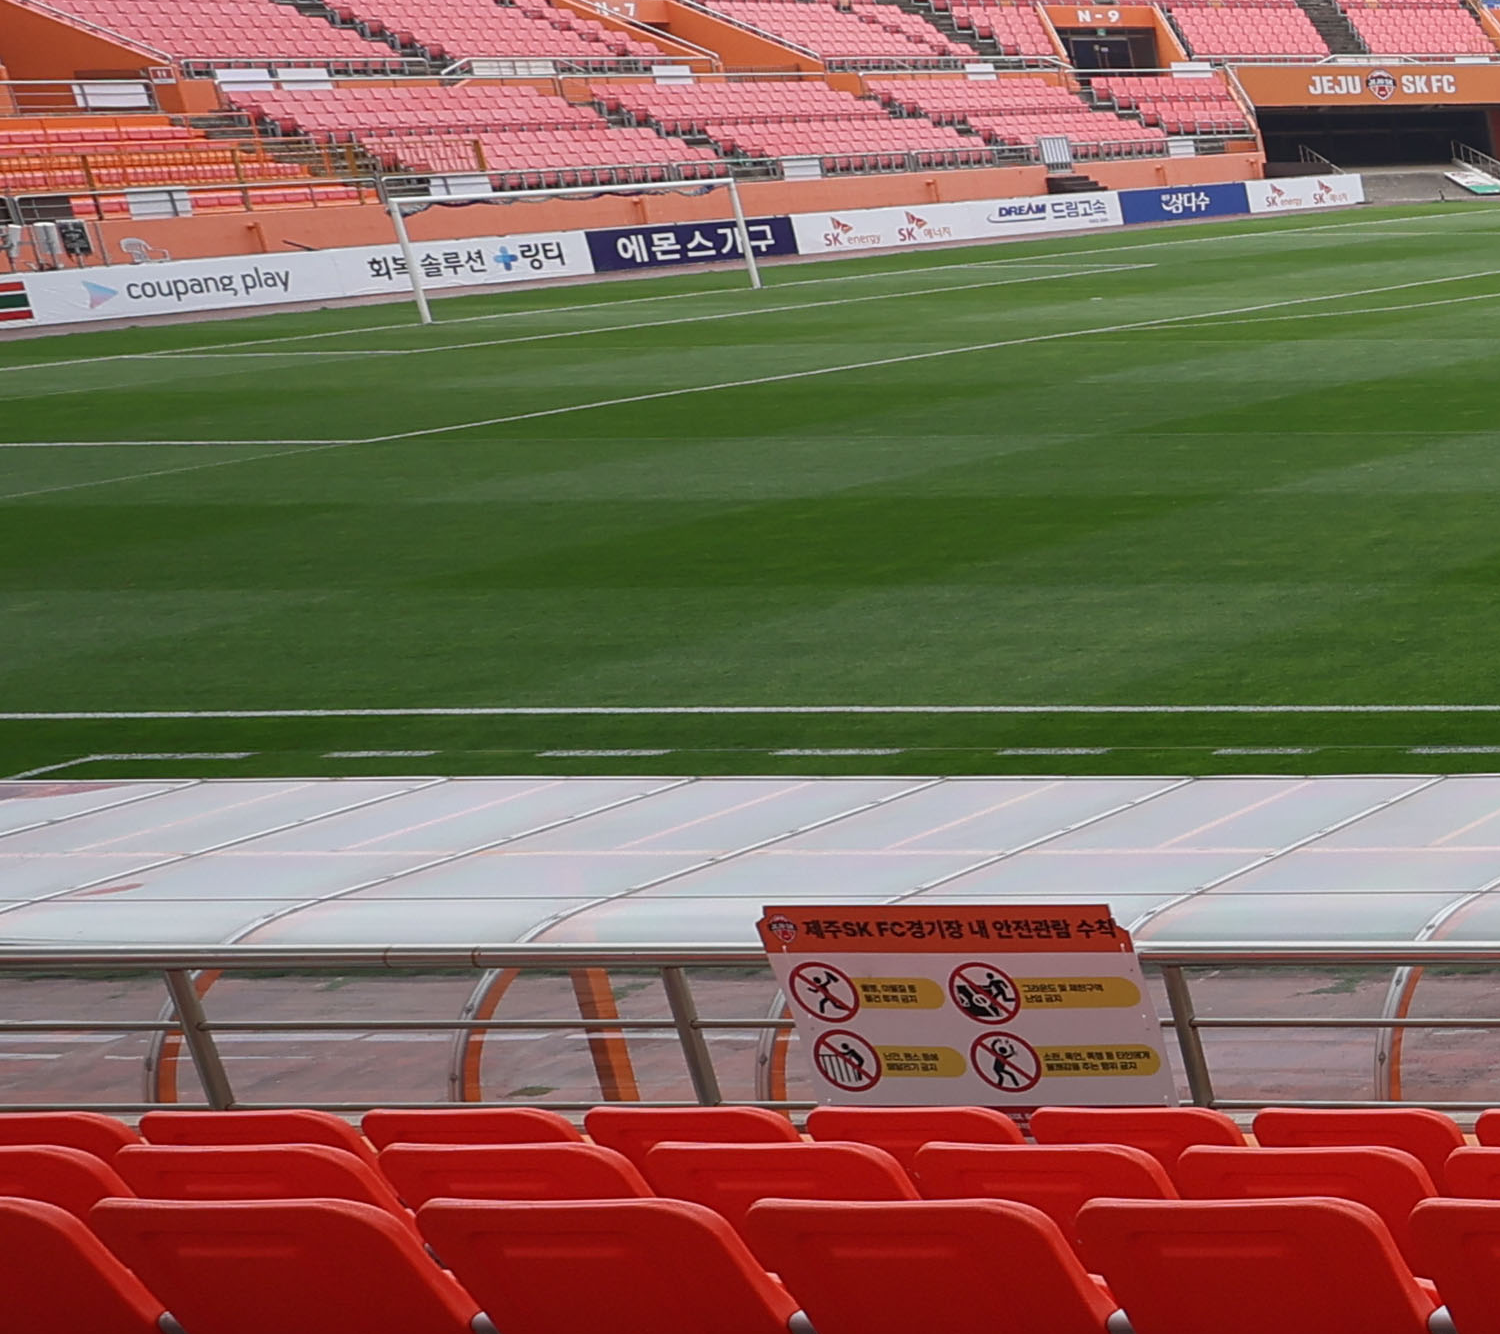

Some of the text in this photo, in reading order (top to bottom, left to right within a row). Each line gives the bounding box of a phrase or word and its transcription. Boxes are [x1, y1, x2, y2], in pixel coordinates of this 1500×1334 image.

[1308, 73, 1456, 96] JEJU SK FC
[1162, 192, 1211, 214] 삼다수
[1266, 196, 1278, 208] SK
[1312, 192, 1325, 205] SK
[998, 199, 1108, 220] DREAM 드림고속
[616, 225, 776, 264] 에몬스가구
[824, 232, 882, 247] SK energy
[898, 227, 917, 242] SK
[420, 250, 485, 278] 솔루션
[518, 241, 566, 271] 링티
[126, 267, 291, 303] coupang play
[805, 919, 1117, 940] 제주SK FC경기장 내 안전관람 수칙
